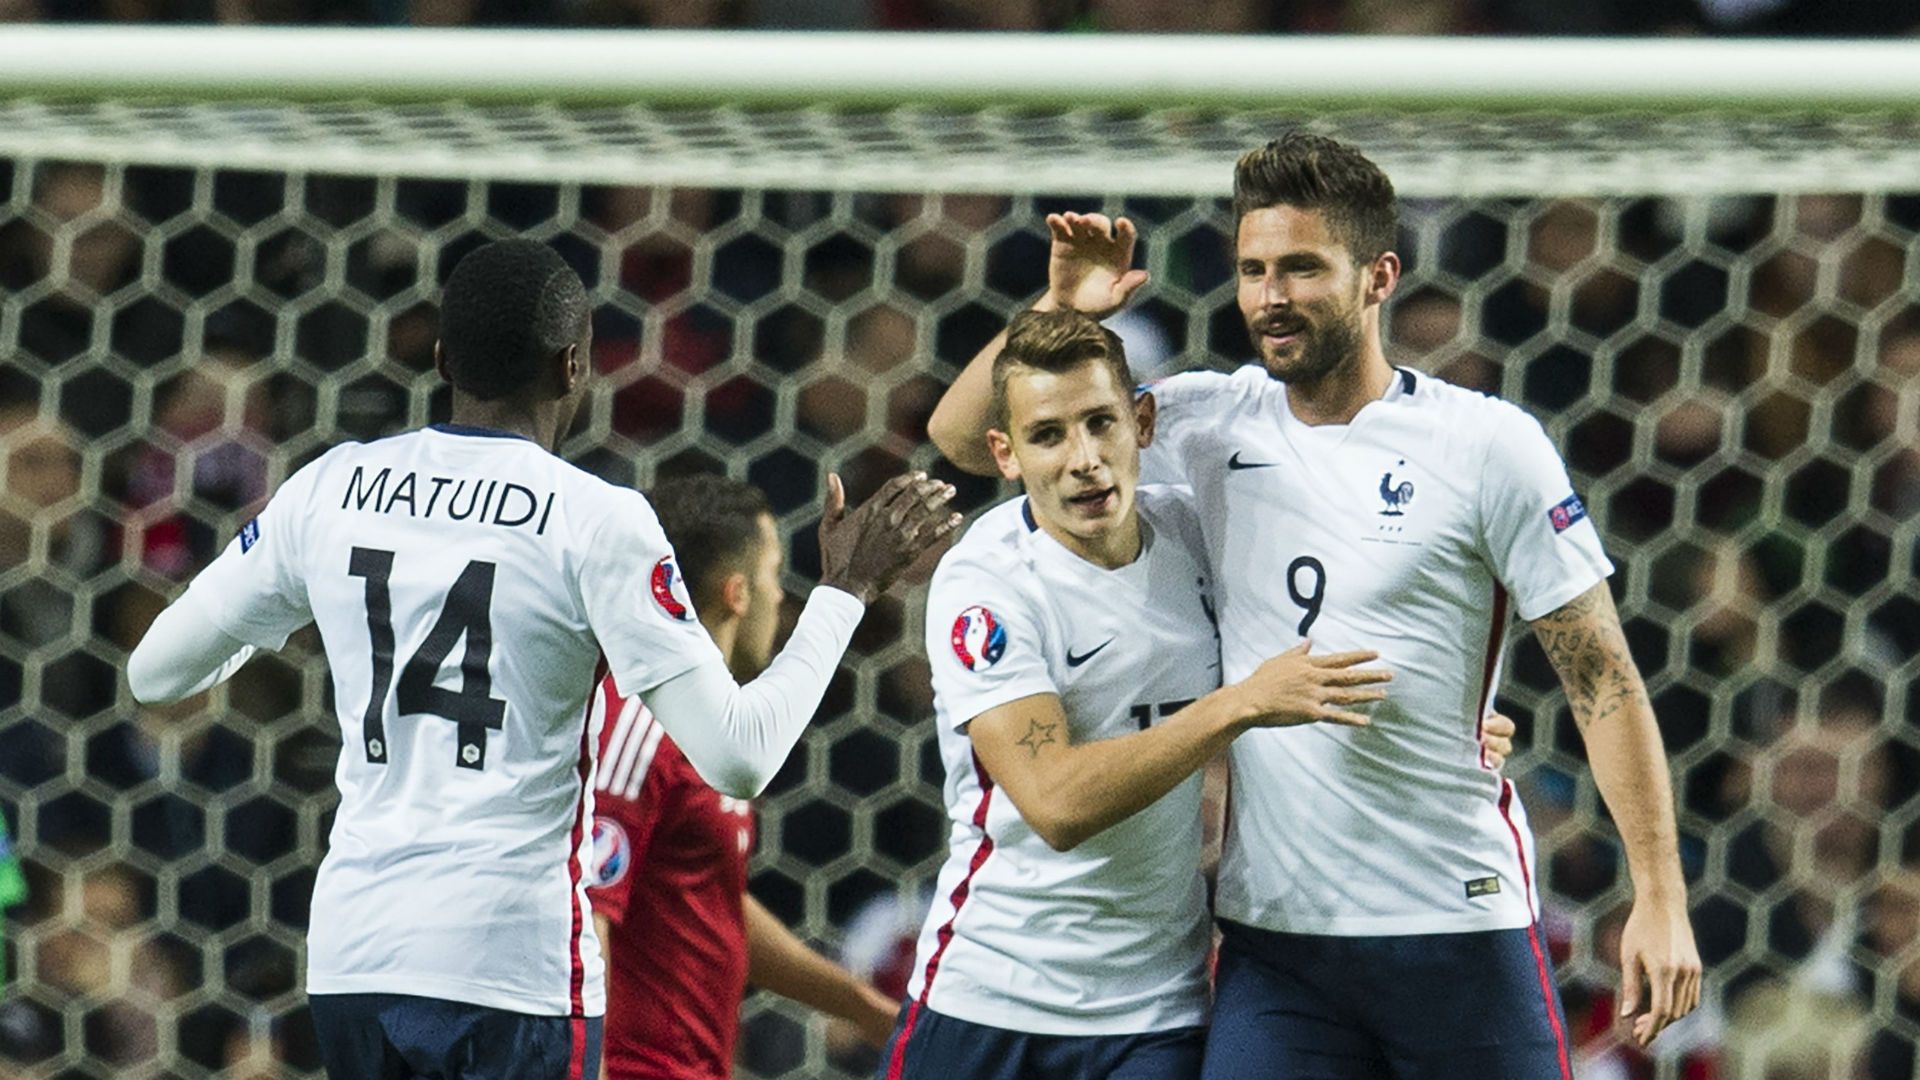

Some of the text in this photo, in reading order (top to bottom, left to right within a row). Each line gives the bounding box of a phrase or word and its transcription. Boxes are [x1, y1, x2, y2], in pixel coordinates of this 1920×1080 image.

[341, 465, 556, 536] MATUIDI
[1286, 555, 1327, 638] 9
[348, 545, 507, 771] 14
